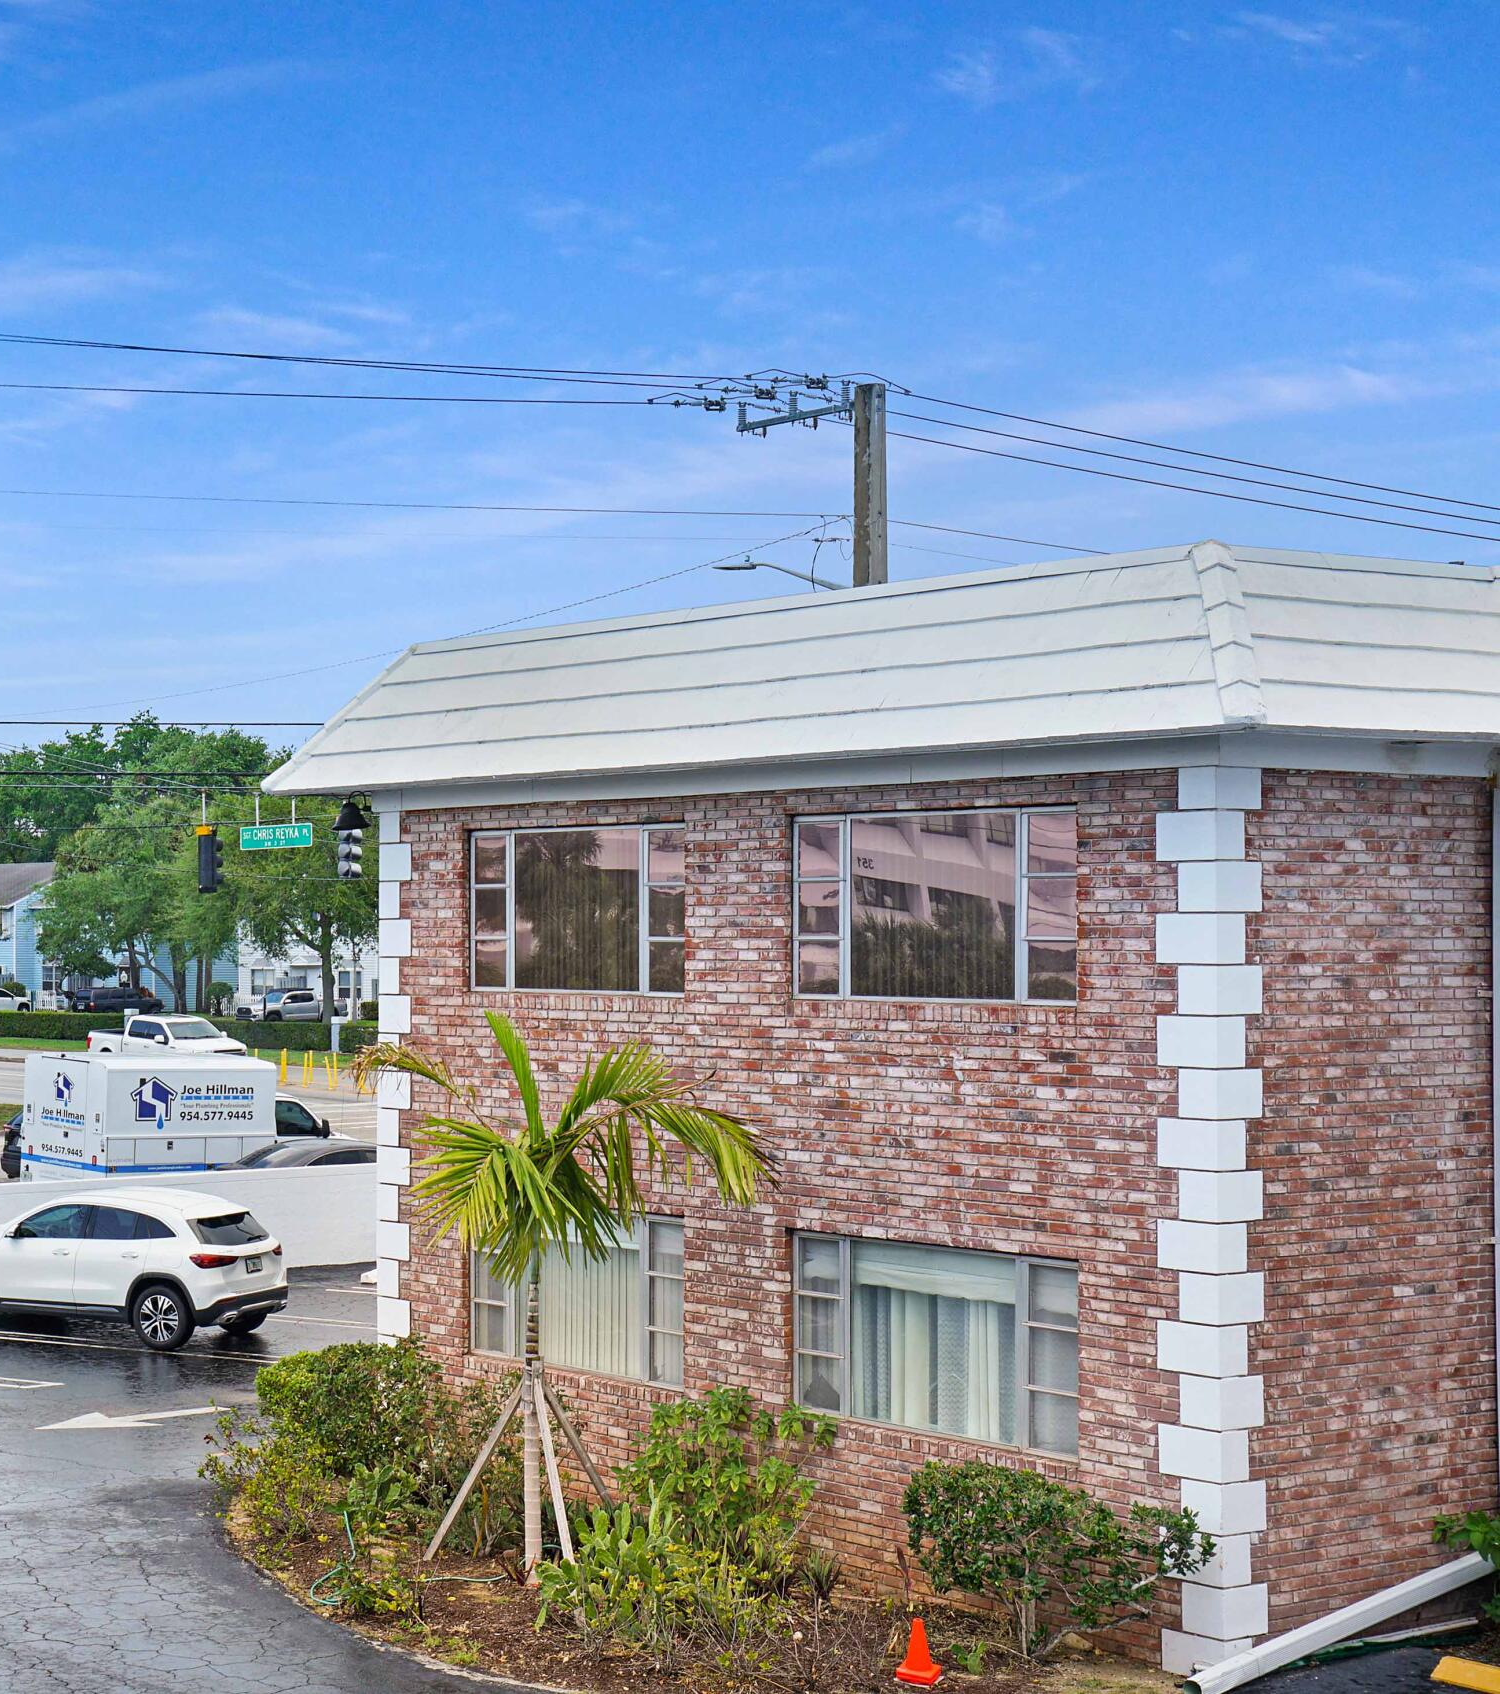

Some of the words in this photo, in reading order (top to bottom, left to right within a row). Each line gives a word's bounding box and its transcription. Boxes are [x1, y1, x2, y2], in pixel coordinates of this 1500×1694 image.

[253, 828, 274, 840] CHRIS
[276, 827, 299, 839] REYKA
[302, 828, 309, 836] PL
[181, 1084, 202, 1095] Joe
[206, 1084, 254, 1095] Hillman
[41, 1106, 55, 1116] Joe
[56, 1108, 85, 1121] Hllman
[179, 1110, 254, 1121] 954.577.9445
[41, 1143, 83, 1158] 954.577.9445
